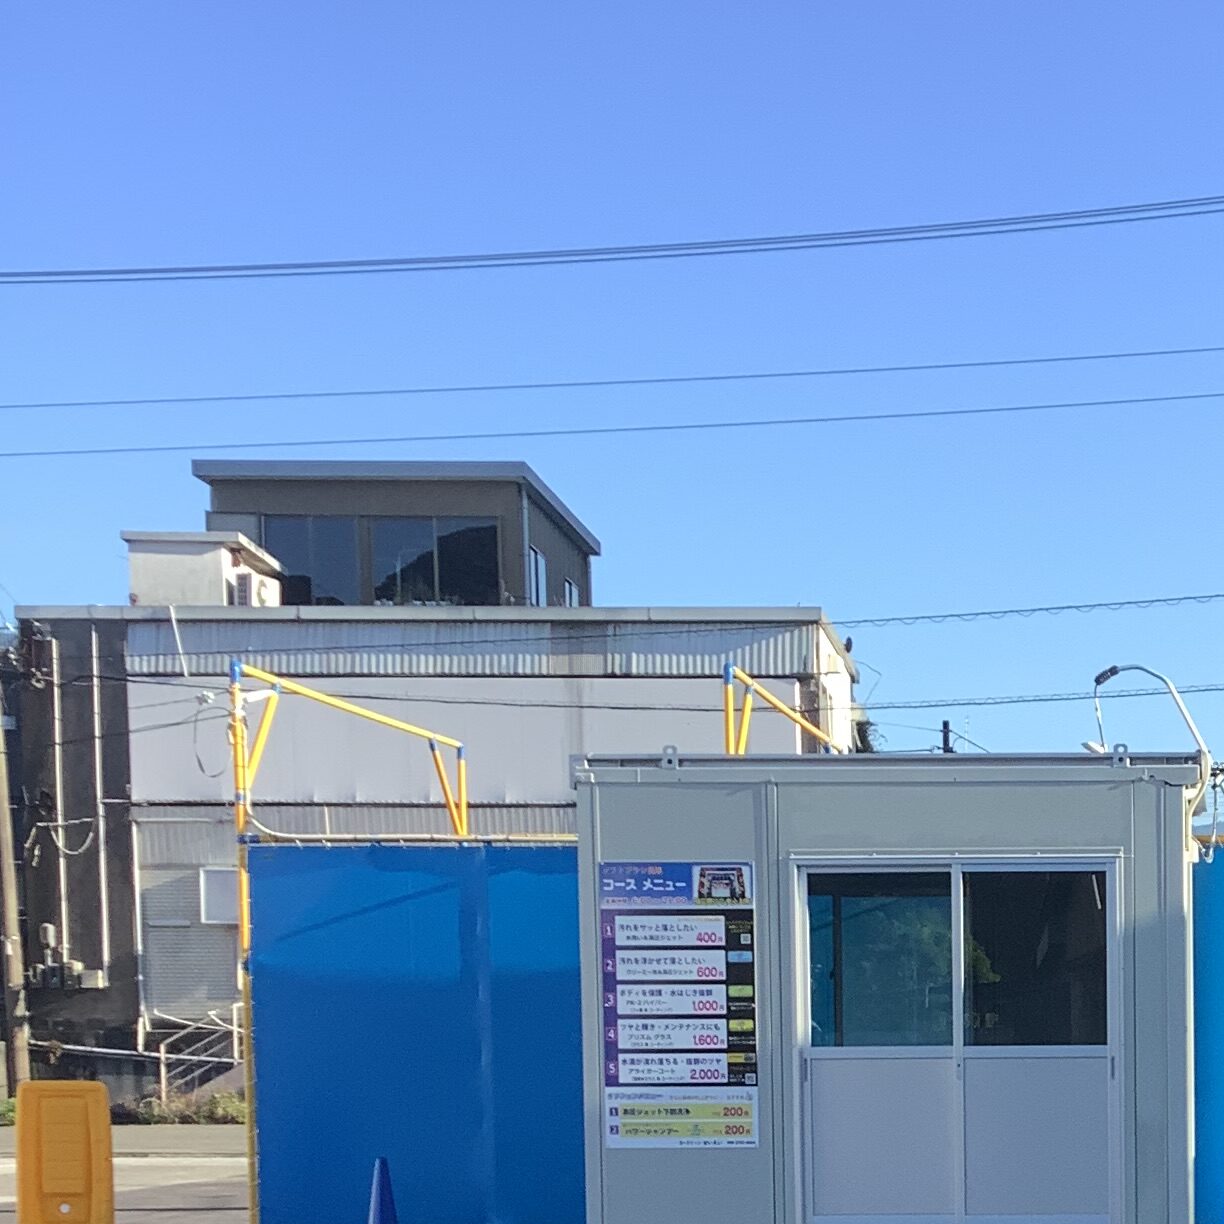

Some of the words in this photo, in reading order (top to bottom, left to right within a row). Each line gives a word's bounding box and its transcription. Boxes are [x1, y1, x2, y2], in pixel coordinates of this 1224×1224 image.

[602, 878, 638, 891] コース
[642, 877, 687, 891] メニュー
